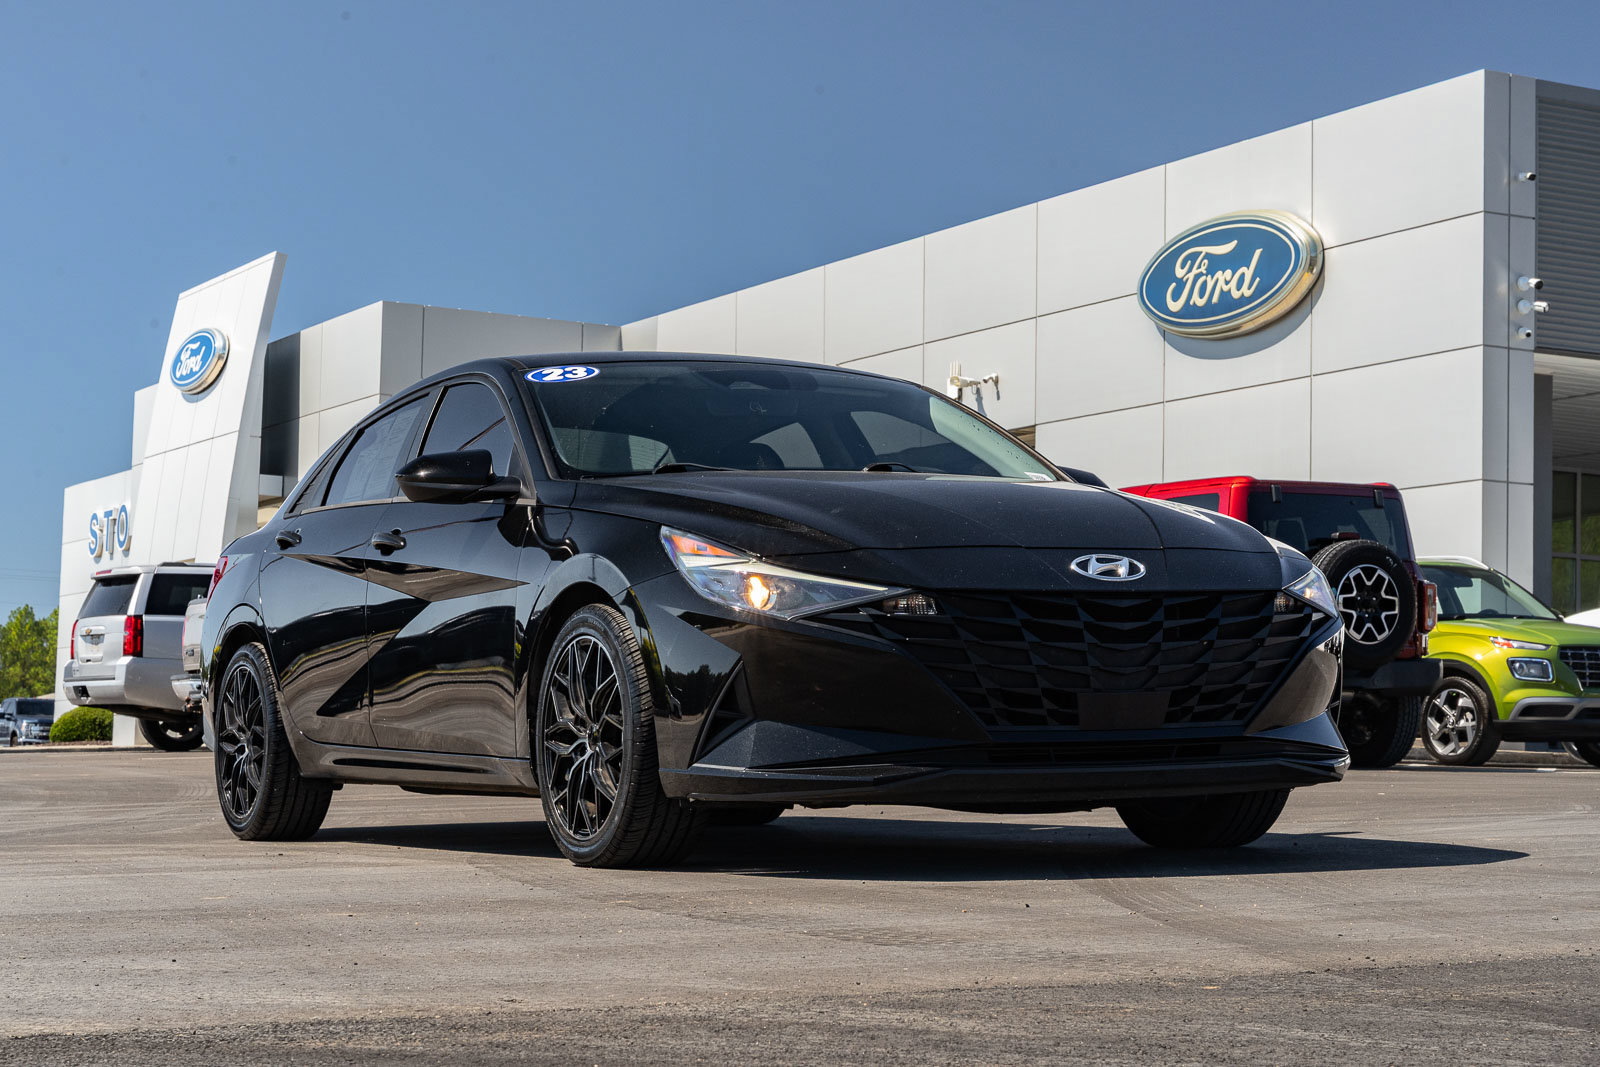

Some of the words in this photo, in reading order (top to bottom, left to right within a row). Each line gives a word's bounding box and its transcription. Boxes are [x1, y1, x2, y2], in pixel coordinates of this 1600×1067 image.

[1166, 240, 1263, 313] Ford
[175, 341, 206, 379] Ford
[541, 366, 588, 381] 23
